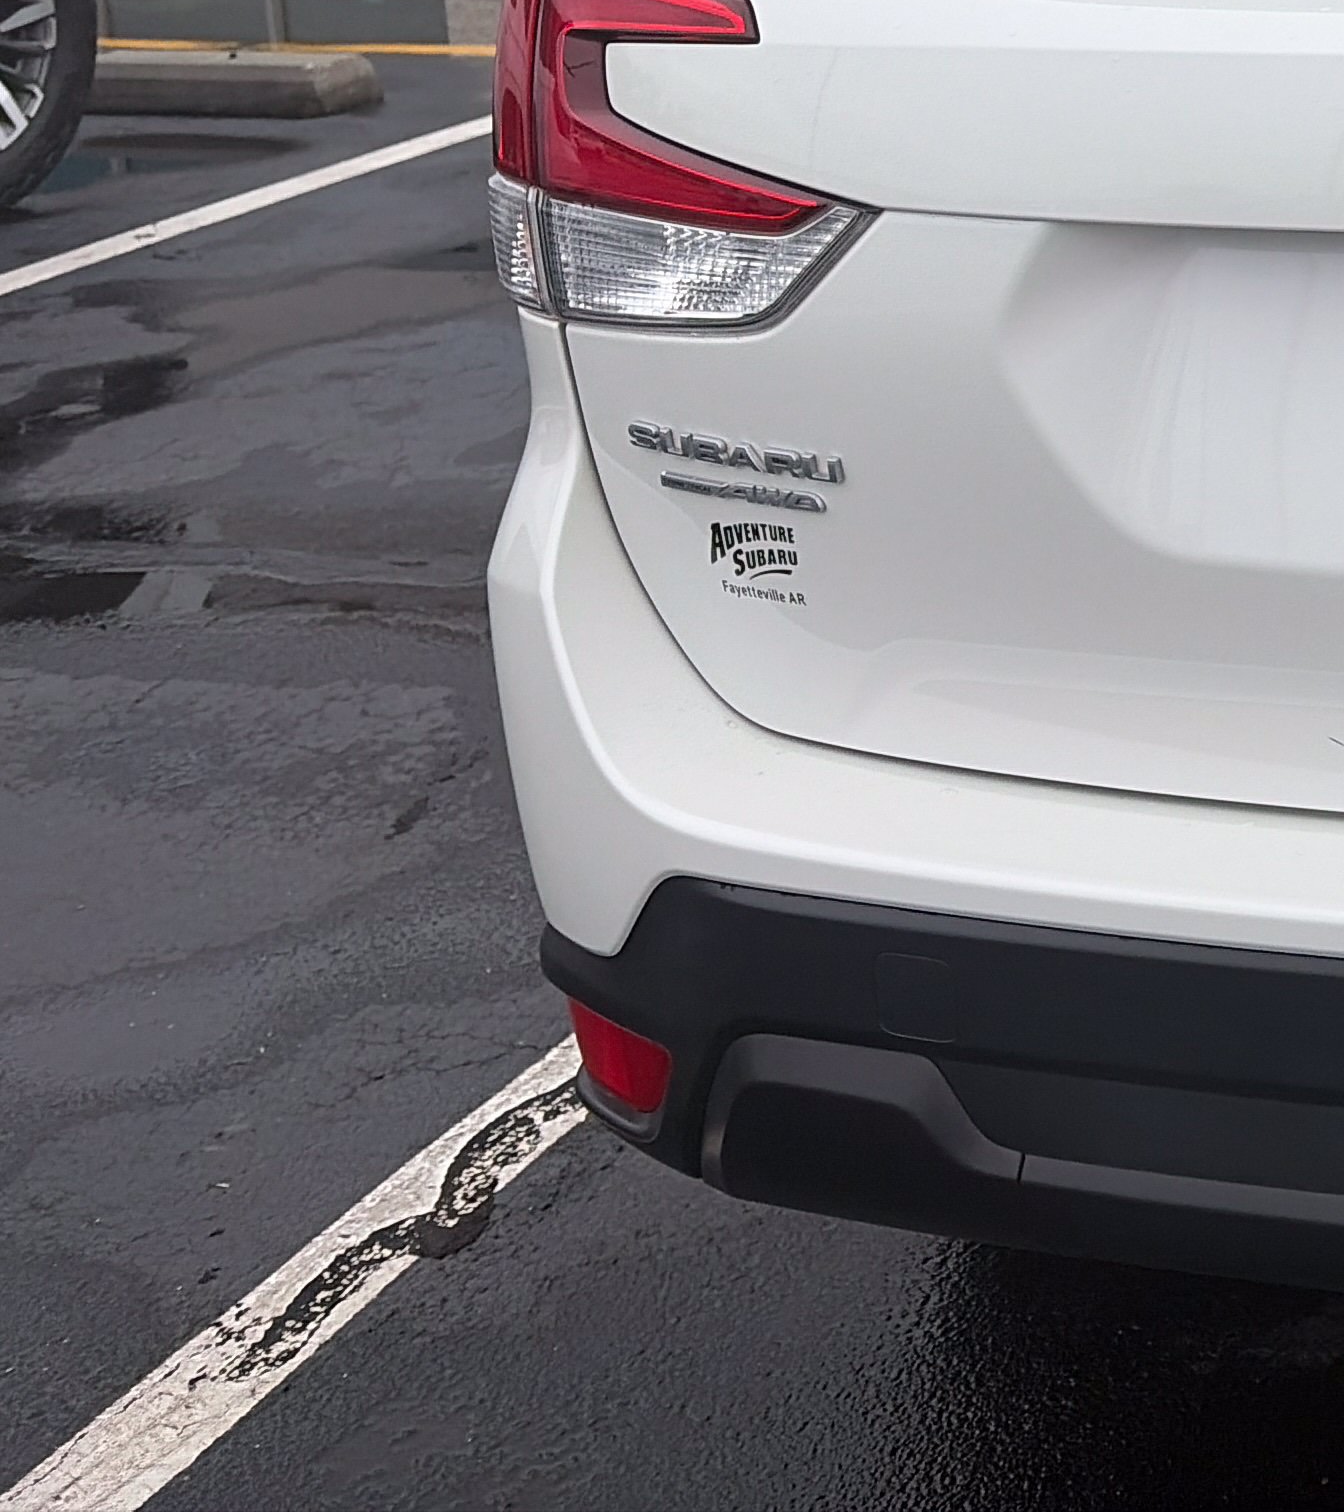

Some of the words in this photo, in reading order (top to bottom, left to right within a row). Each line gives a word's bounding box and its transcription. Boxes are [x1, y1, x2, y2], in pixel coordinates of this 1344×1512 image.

[628, 420, 845, 484] SUBARU
[710, 522, 795, 565] ADVENTURE
[732, 548, 798, 576] SUBARU
[721, 579, 787, 604] Fayetteville
[789, 591, 807, 607] AR
